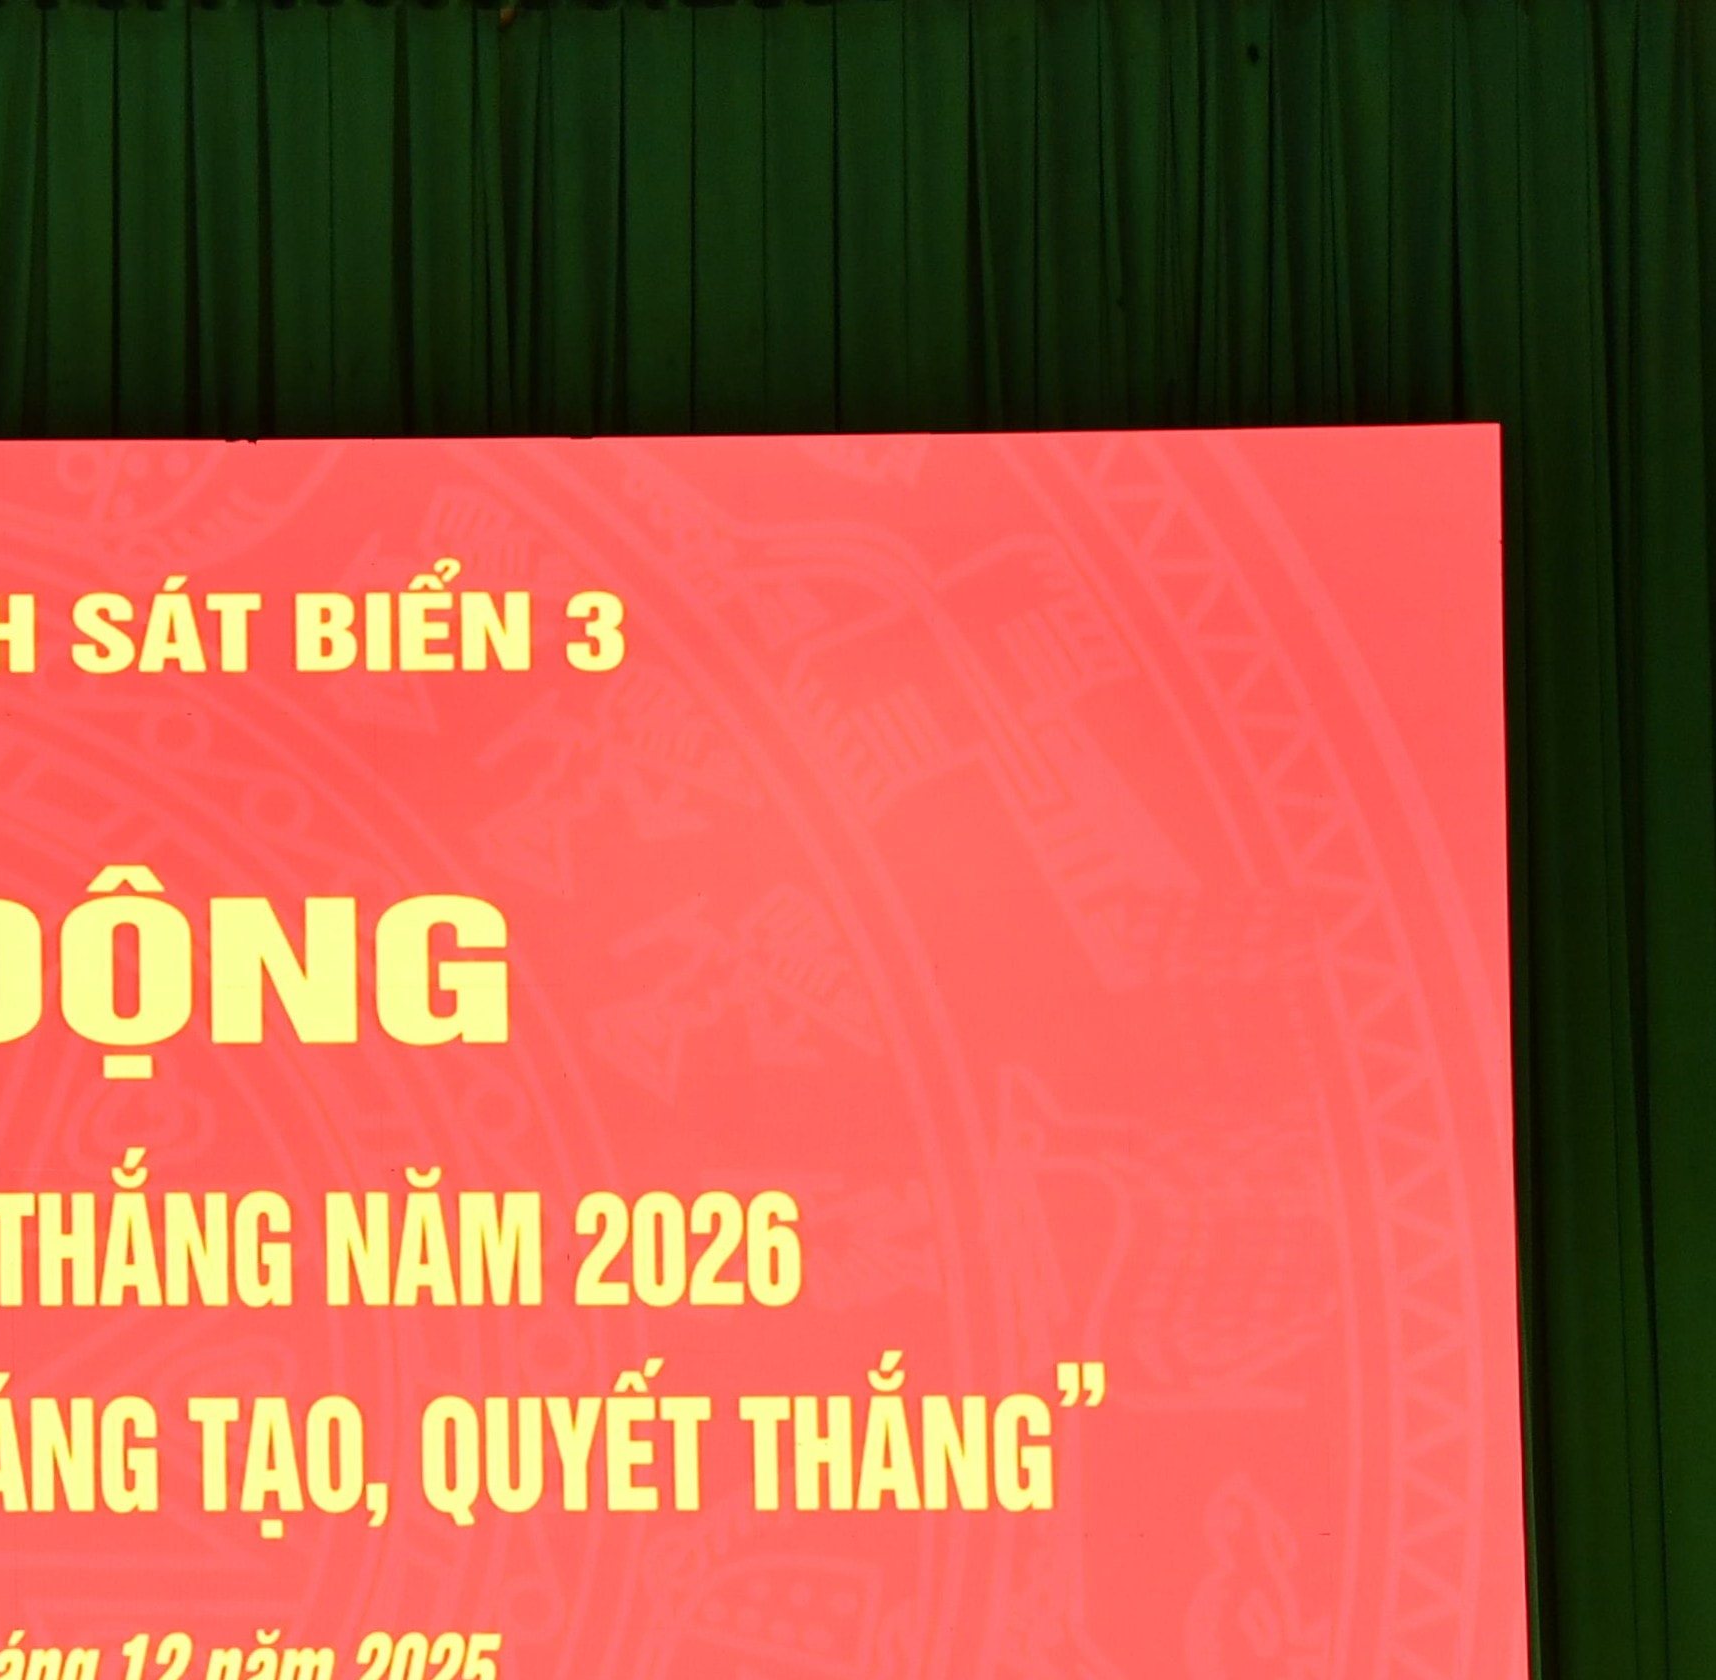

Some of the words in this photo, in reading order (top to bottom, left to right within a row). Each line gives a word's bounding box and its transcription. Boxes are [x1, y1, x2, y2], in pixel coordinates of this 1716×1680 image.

[72, 575, 262, 674] SÁT
[295, 558, 531, 672] BIỂN
[566, 591, 625, 672] 3
[325, 1166, 542, 1307] NĂM
[575, 1190, 802, 1307] 2026
[188, 1395, 388, 1539] TẠO,
[421, 1357, 712, 1526] QUYẾT
[739, 1350, 1105, 1512] THẮNG”
